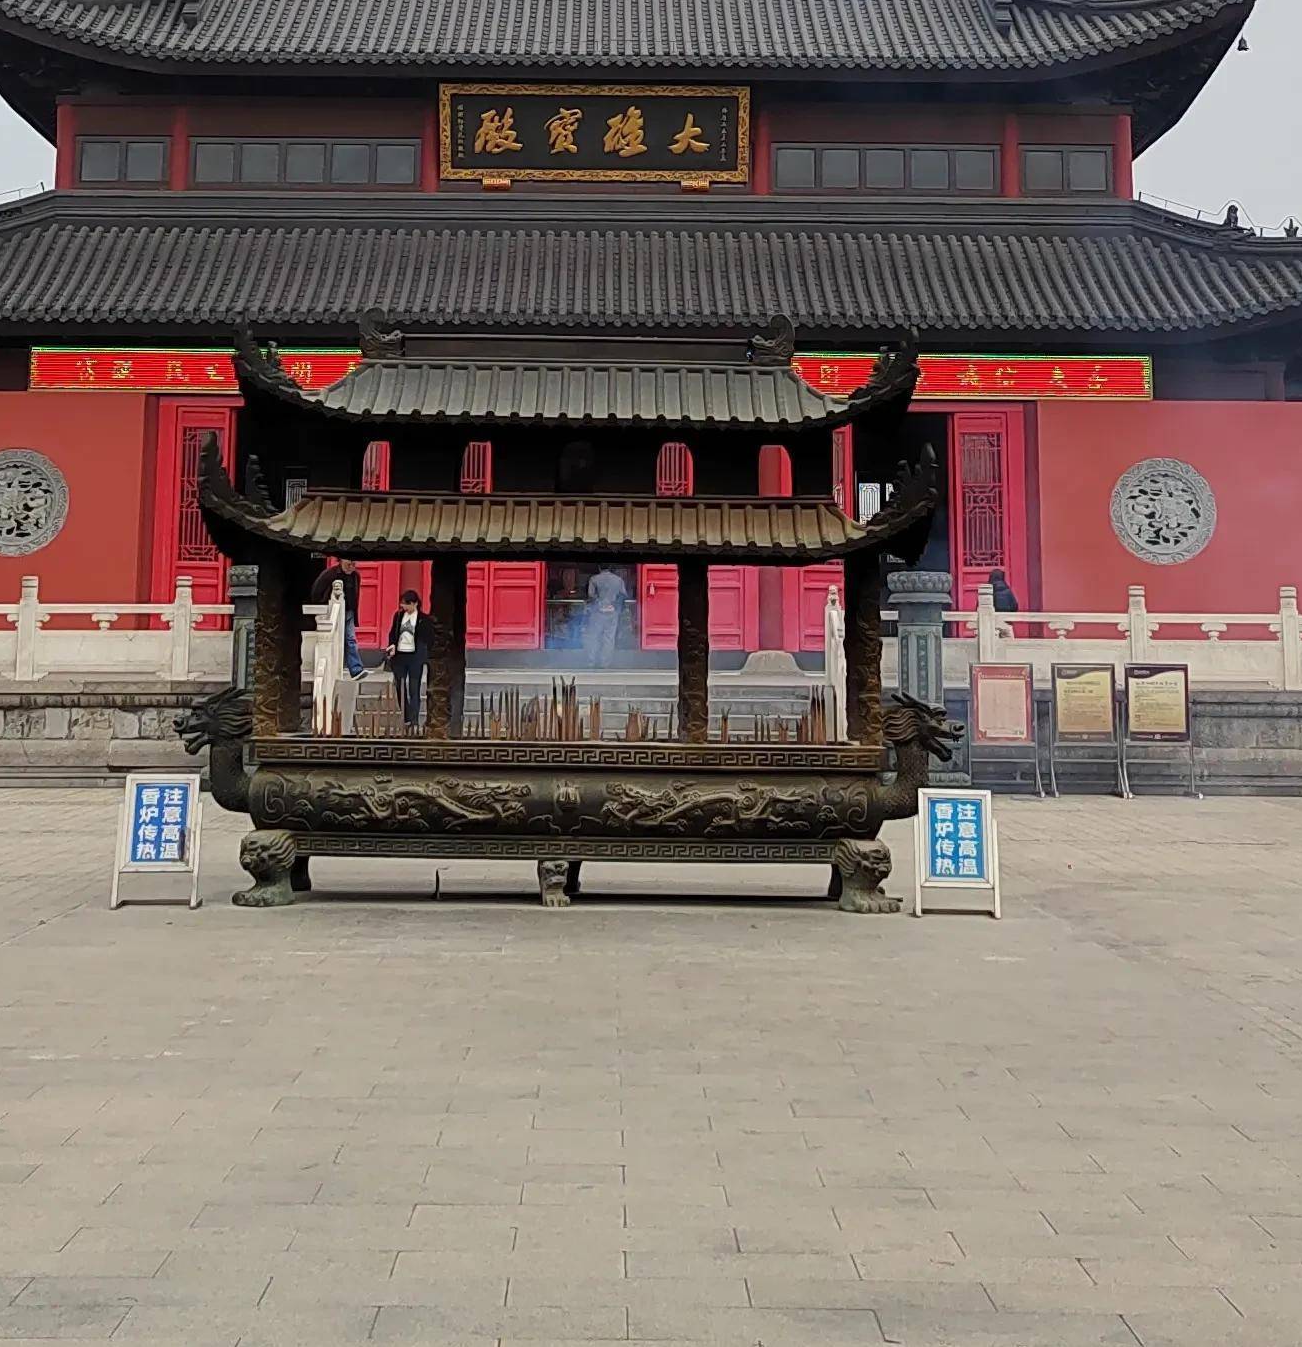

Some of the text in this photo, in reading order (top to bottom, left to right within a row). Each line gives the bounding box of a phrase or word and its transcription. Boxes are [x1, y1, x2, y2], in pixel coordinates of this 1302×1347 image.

[136, 787, 160, 860] 香炉传热
[160, 788, 184, 859] 注意高温
[934, 802, 956, 875] 香炉传热
[956, 803, 980, 876] 注意高温
